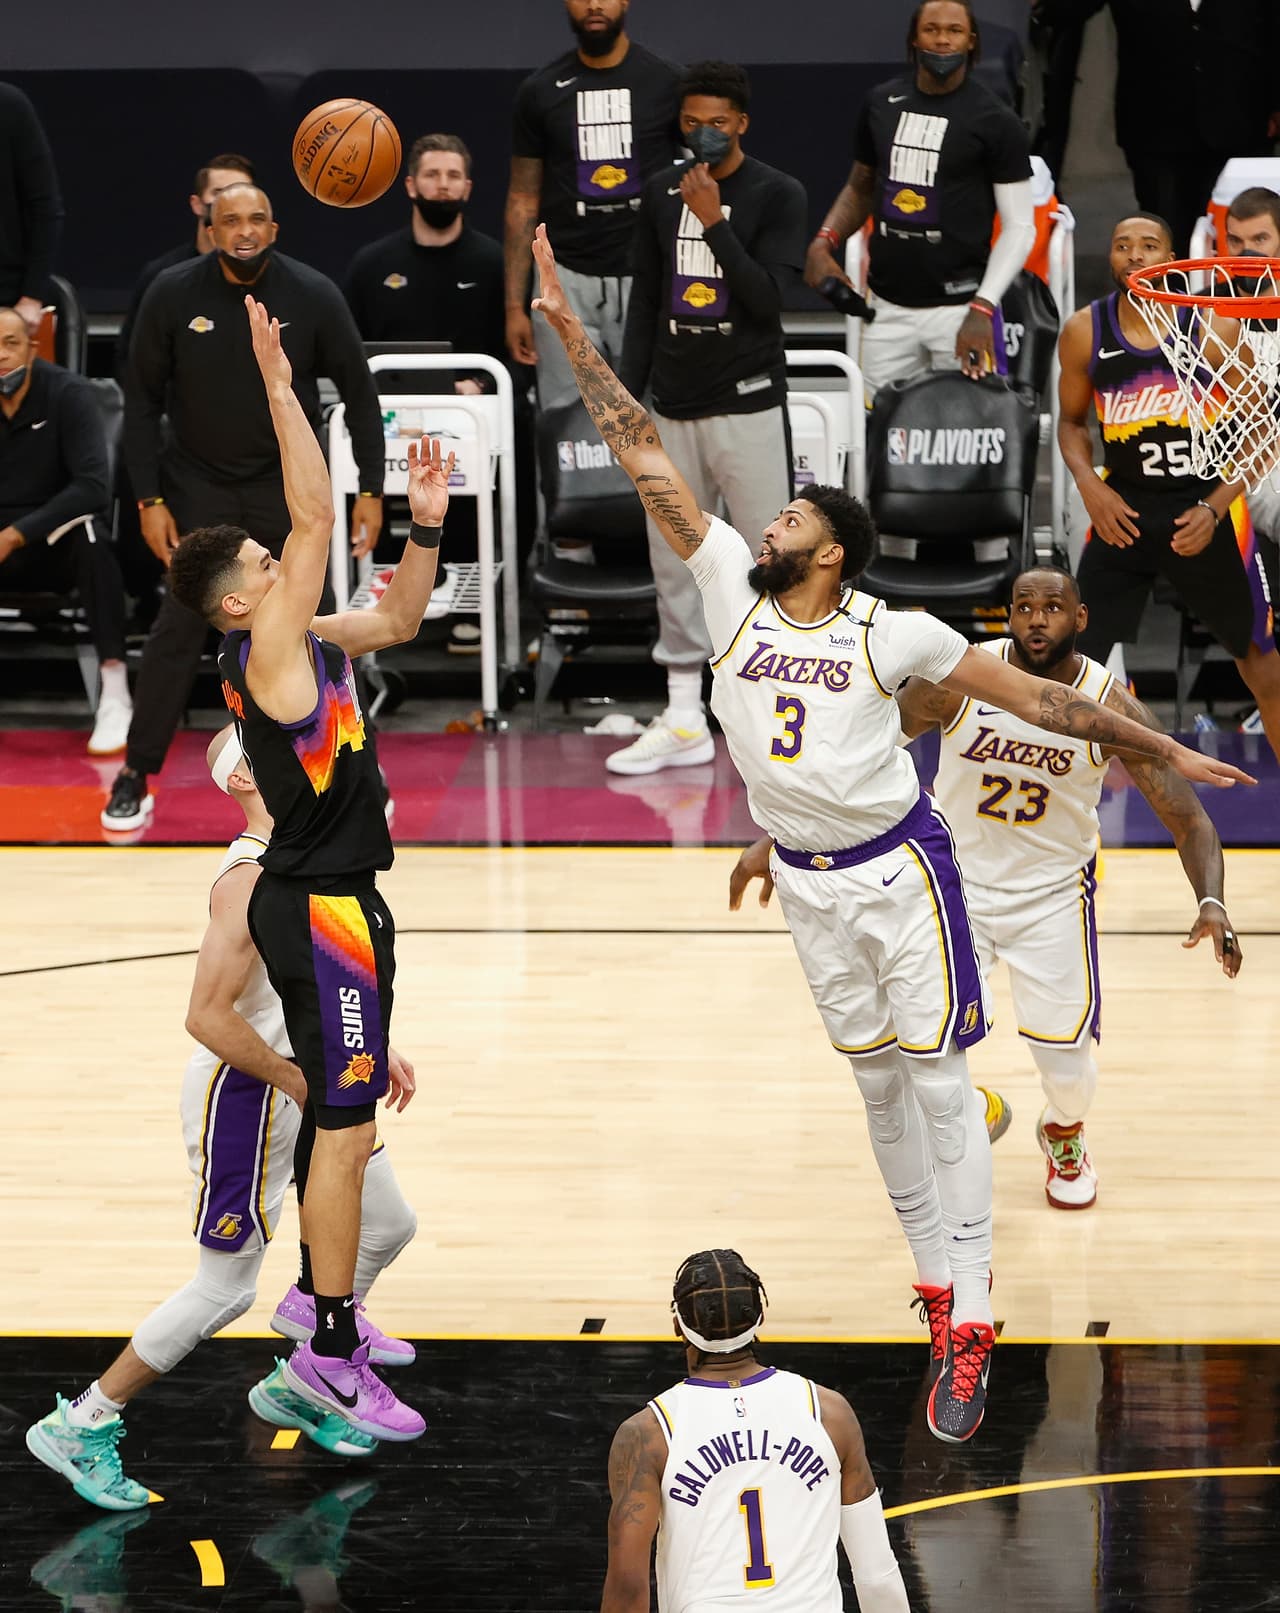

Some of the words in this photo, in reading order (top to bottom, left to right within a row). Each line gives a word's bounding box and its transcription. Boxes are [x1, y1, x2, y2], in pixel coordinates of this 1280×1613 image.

[301, 121, 338, 175] ALDING
[1102, 383, 1189, 424] Valley
[574, 439, 620, 470] that
[907, 428, 1006, 465] PLAYOFFS
[1139, 440, 1192, 477] 25
[829, 633, 856, 647] wish
[736, 641, 853, 693] LAKERS
[769, 694, 807, 763] 3
[960, 726, 1076, 777] LAKERS
[976, 773, 1050, 827] 23
[338, 986, 365, 1049] SUNS
[669, 1429, 830, 1508] CALDWELL-POPE
[738, 1487, 775, 1590] 1
